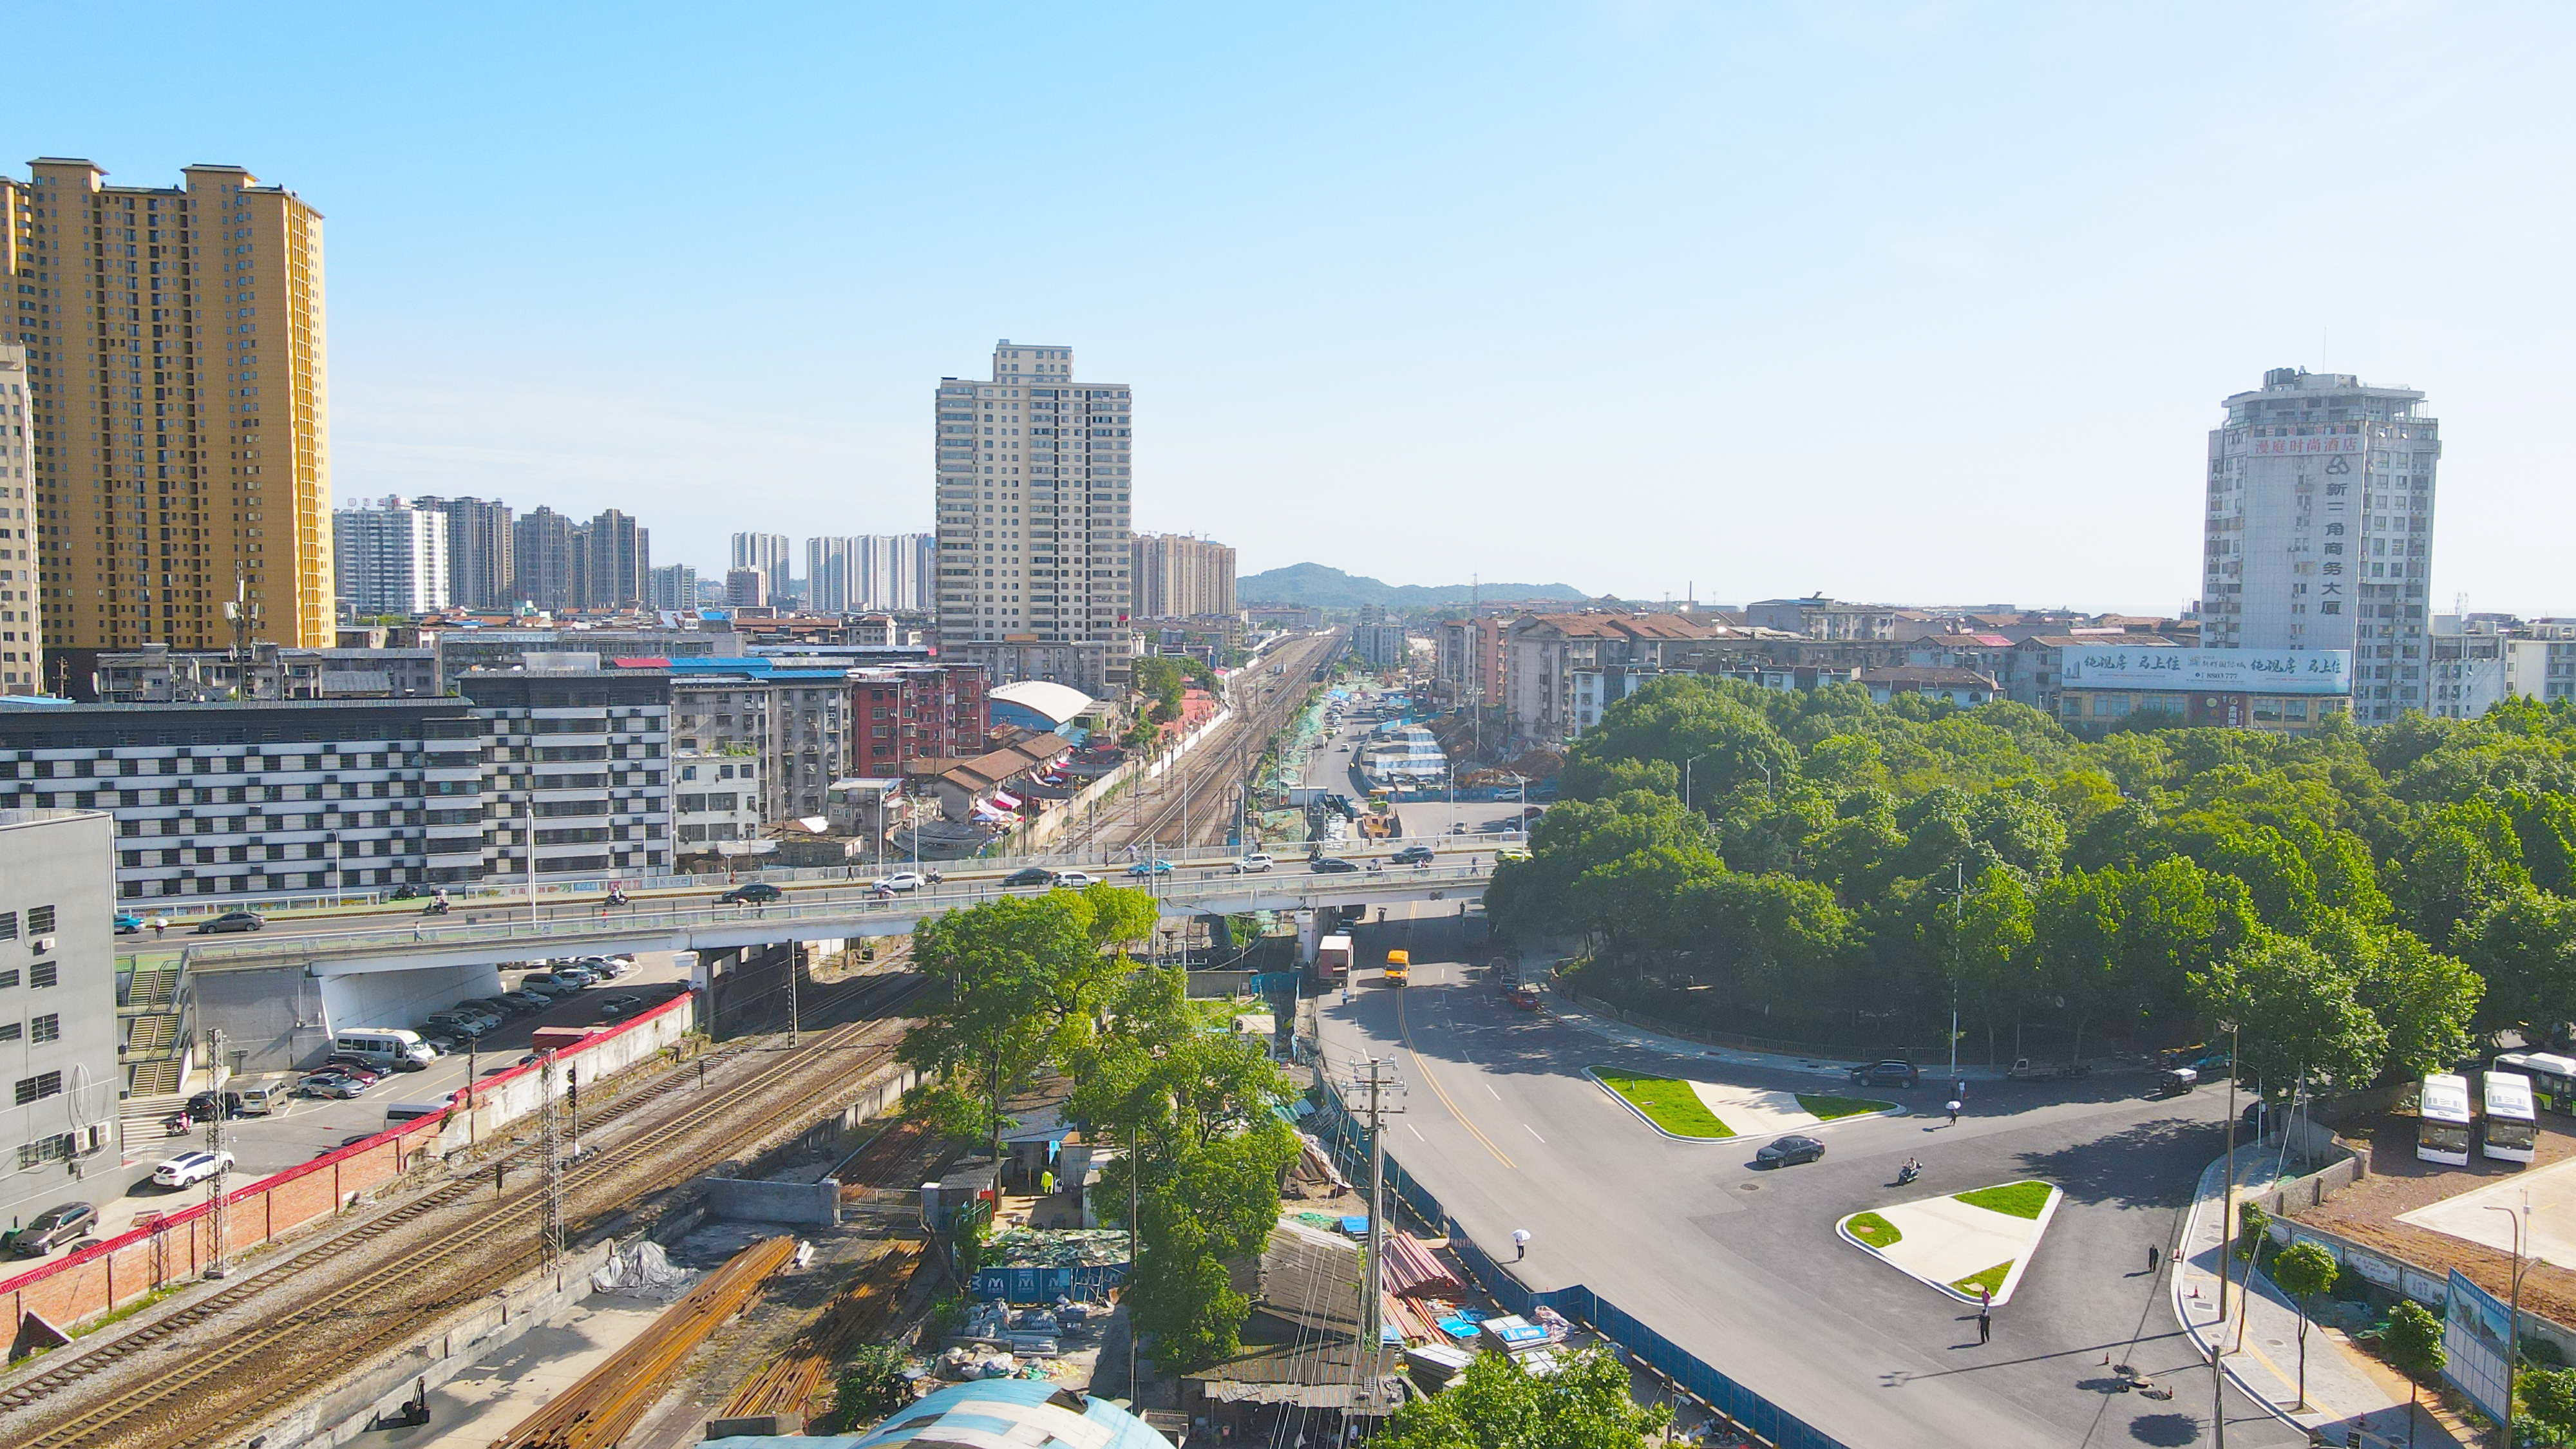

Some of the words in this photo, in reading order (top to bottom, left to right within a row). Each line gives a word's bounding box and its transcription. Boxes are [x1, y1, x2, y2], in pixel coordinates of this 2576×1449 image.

[2320, 483, 2347, 615] 新三角商务大厦
[2084, 654, 2126, 670] 纯现房
[2138, 655, 2181, 670] 马上住
[2251, 656, 2297, 674] 纯现房
[2308, 658, 2341, 674] 马上住
